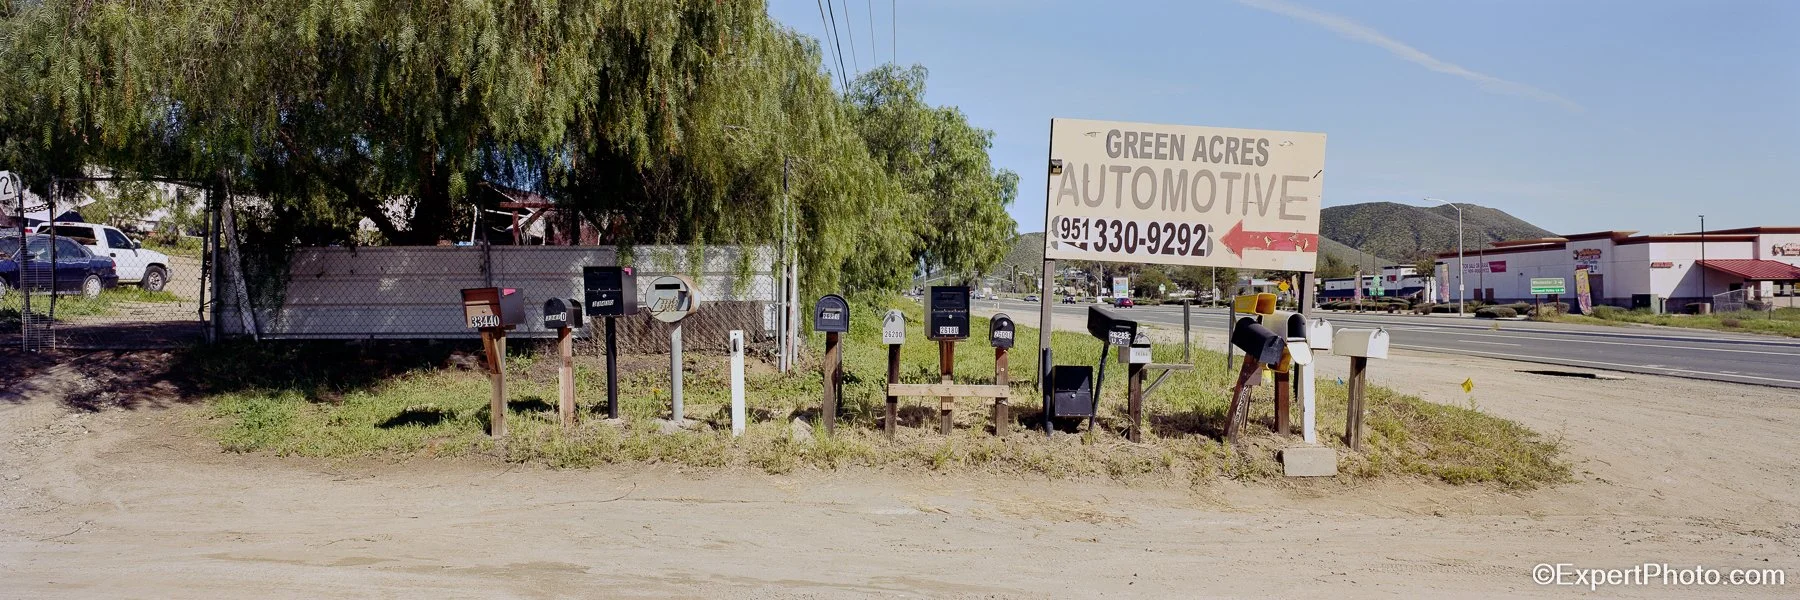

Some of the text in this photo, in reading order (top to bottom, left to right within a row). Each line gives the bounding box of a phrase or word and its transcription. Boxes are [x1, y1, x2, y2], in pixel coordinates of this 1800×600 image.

[1106, 128, 1270, 167] GREEN ACRES
[1057, 161, 1310, 221] AUTOMOTIVE
[1061, 217, 1207, 257] 951 330-9292
[471, 315, 500, 328] 33440
